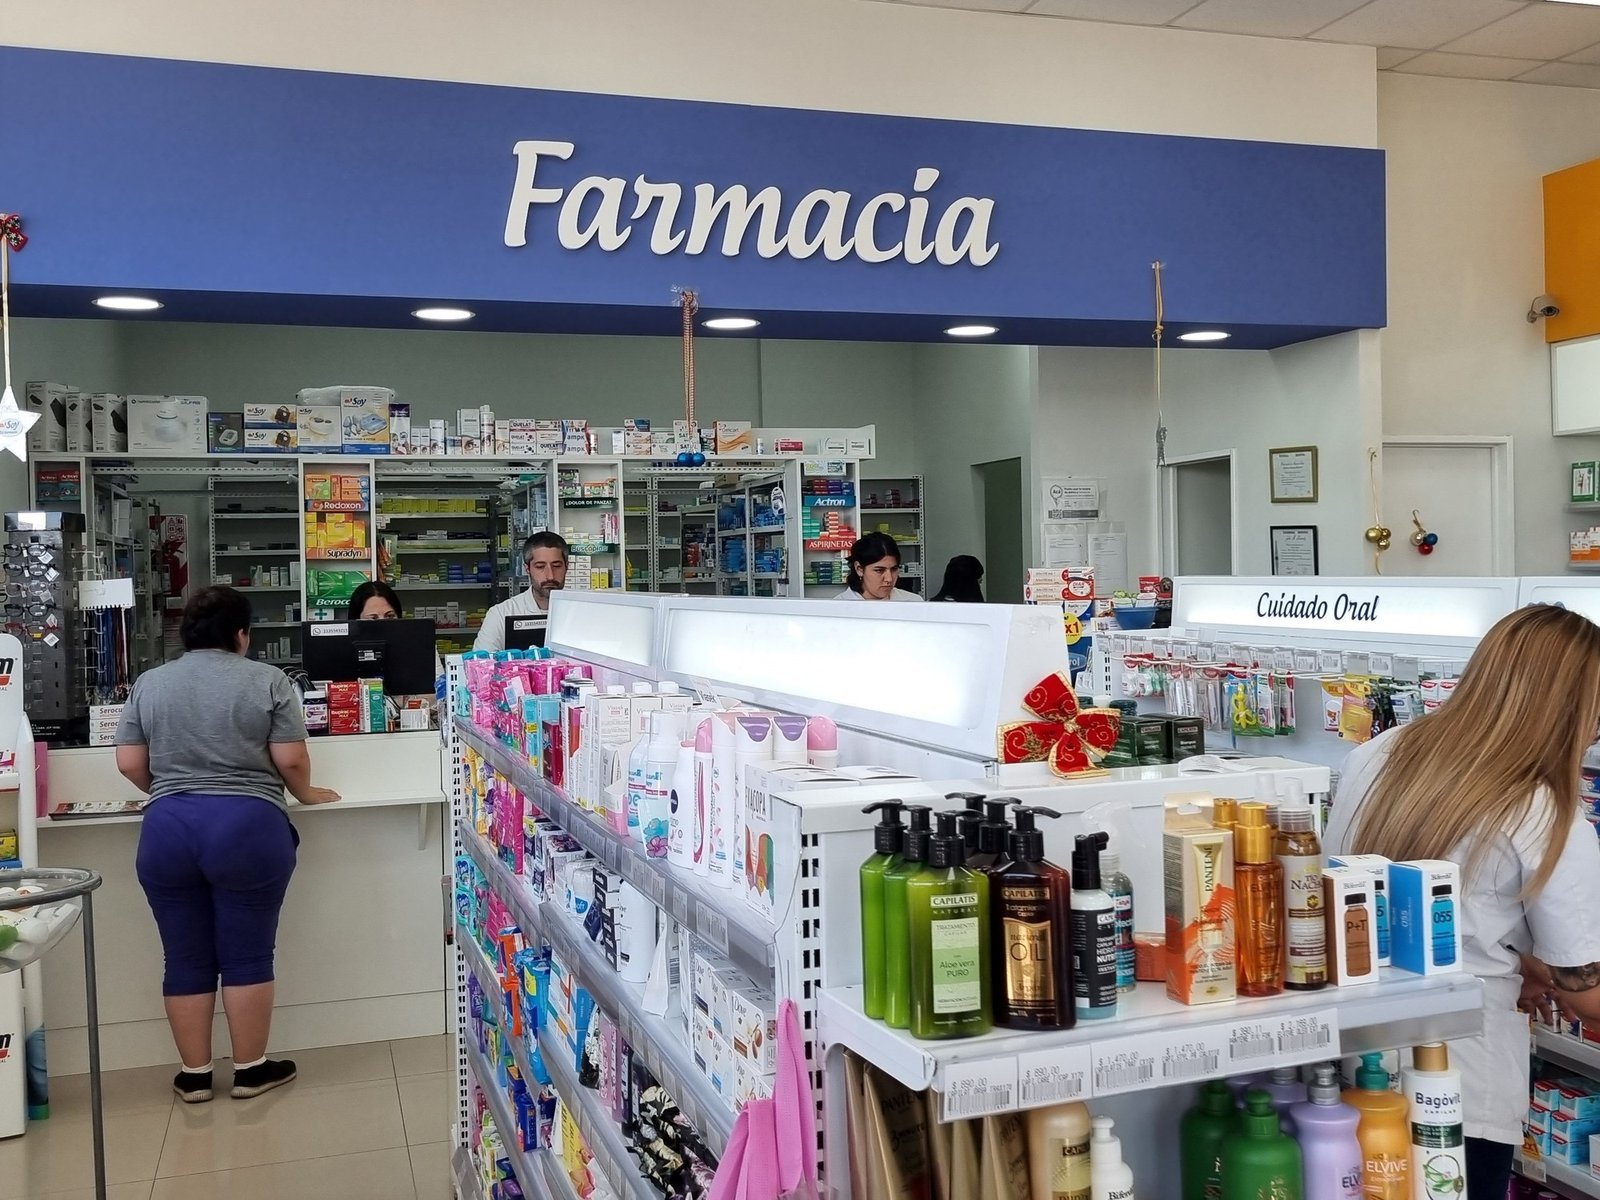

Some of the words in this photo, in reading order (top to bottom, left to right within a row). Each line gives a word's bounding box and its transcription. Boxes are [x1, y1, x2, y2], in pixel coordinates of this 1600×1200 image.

[503, 140, 1000, 267] Farmacia
[324, 501, 362, 510] Redoxon
[814, 497, 846, 506] Actron
[809, 540, 853, 549] ASPIRINETAS
[327, 549, 362, 559] Supradyn
[1257, 592, 1328, 619] Cuidado
[1334, 593, 1380, 622] Oral
[933, 895, 976, 906] CAPILATIS
[932, 907, 978, 915] NATURAL
[1433, 910, 1453, 924] 055
[1347, 919, 1367, 933] P+T
[1010, 942, 1047, 961] OIL
[940, 961, 957, 969] Aloe
[946, 968, 969, 977] PURO
[1366, 1159, 1408, 1173] ELVIVE
